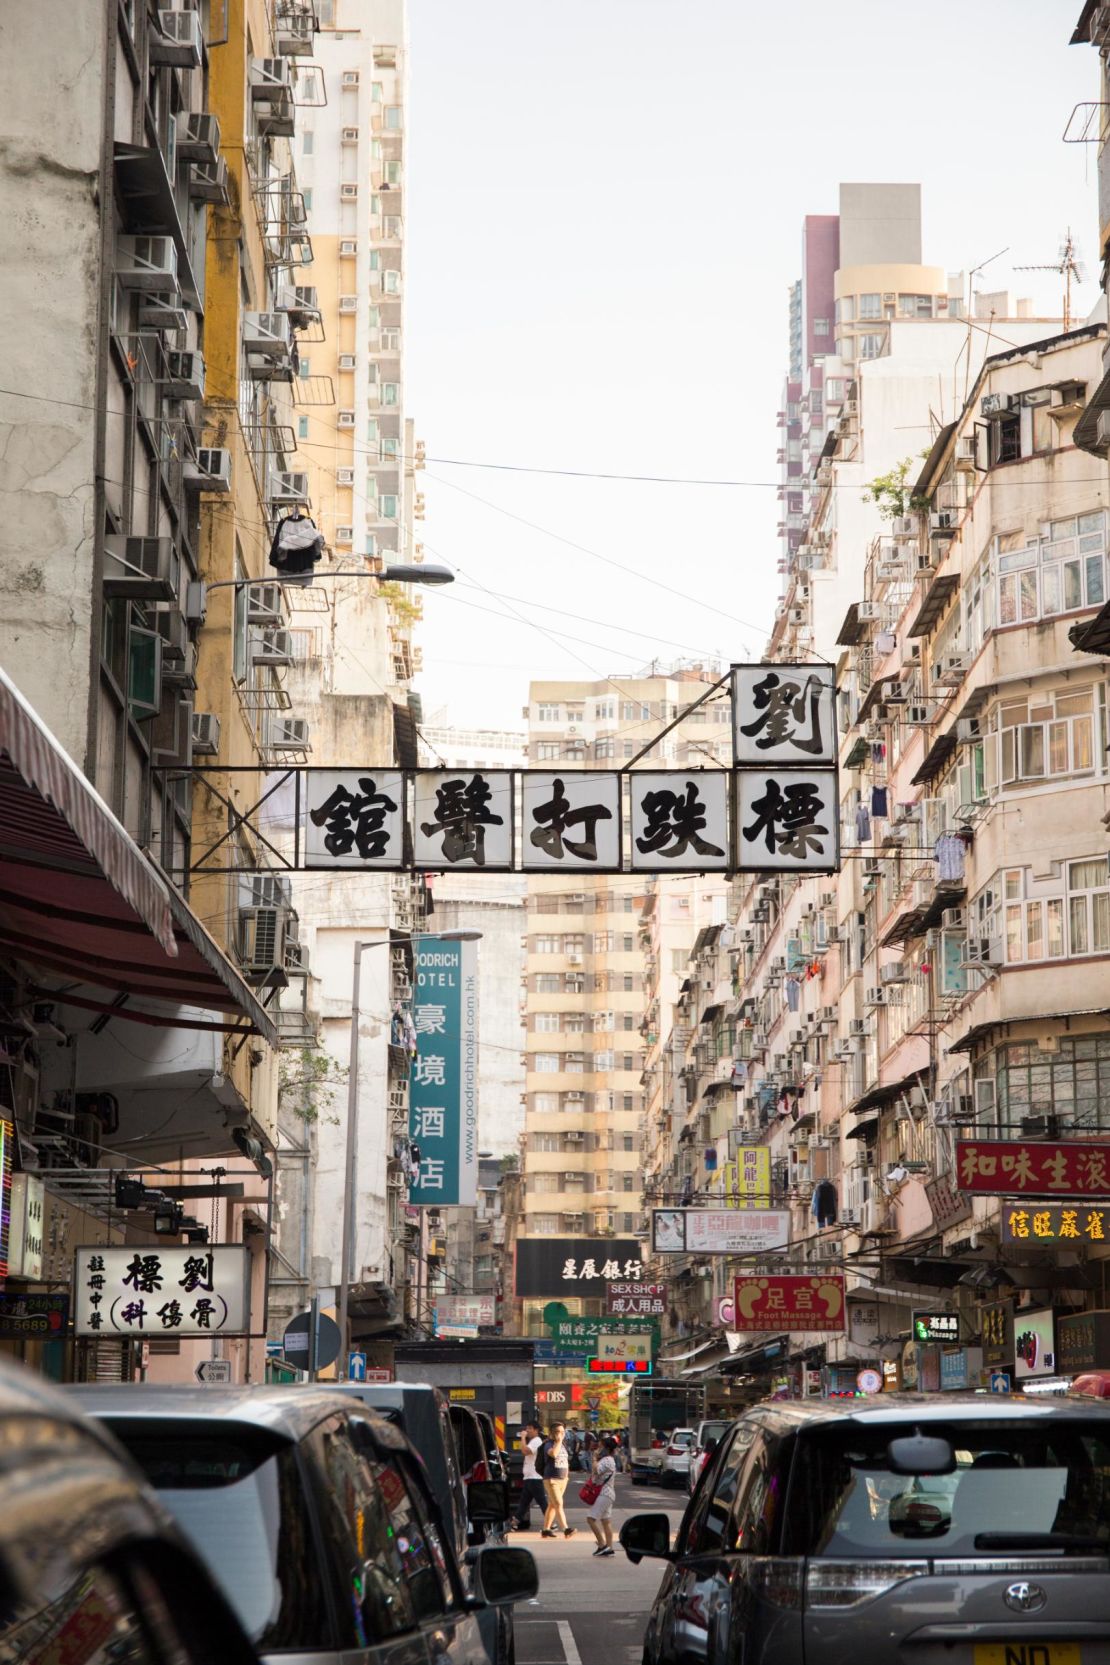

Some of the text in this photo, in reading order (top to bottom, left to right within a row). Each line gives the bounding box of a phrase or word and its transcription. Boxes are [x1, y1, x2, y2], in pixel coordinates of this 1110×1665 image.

[413, 950, 459, 966] OODRICH
[418, 973, 455, 986] OTEL
[413, 1003, 447, 1189] 豪境酒店
[611, 1285, 664, 1294] SEX SHOP
[612, 1300, 664, 1312] 成人用品
[758, 1311, 822, 1321] Foot Massage
[547, 1391, 566, 1403] DBS
